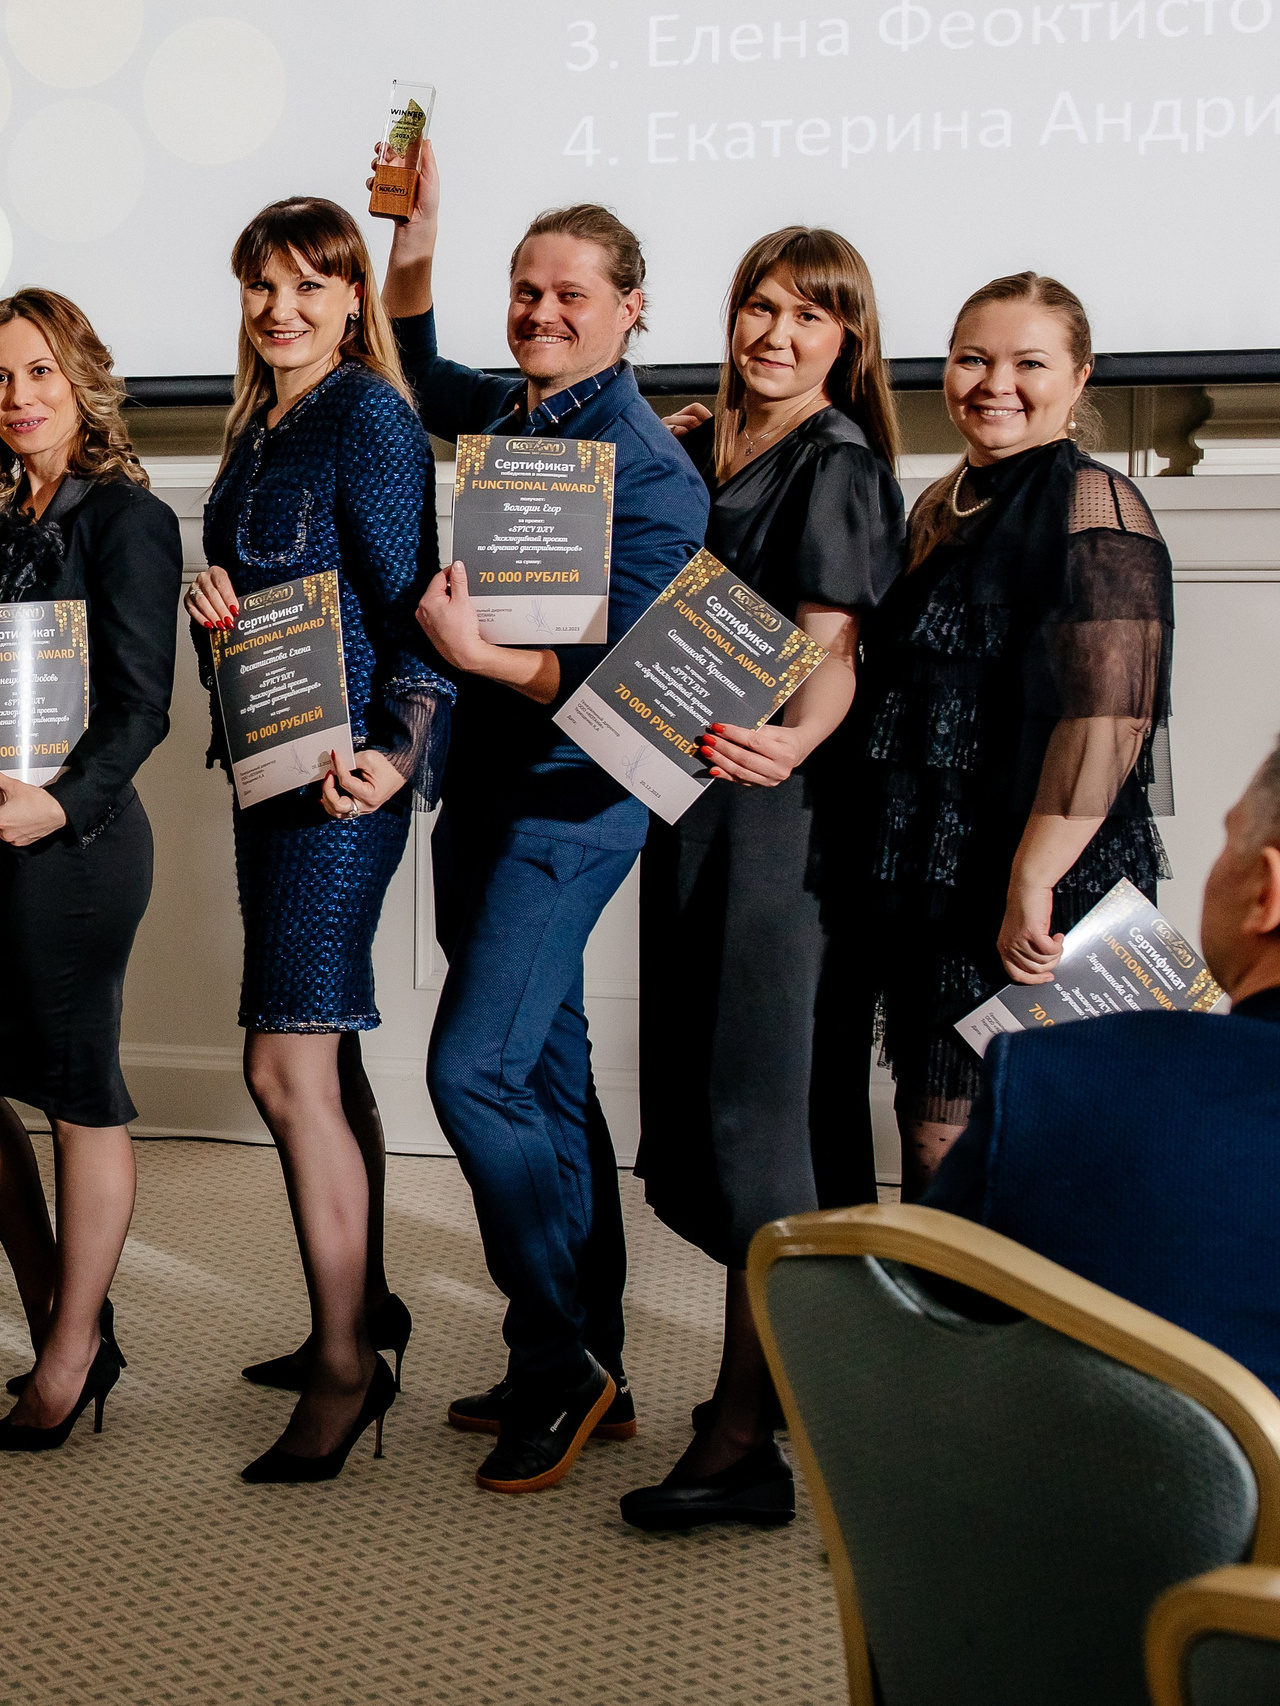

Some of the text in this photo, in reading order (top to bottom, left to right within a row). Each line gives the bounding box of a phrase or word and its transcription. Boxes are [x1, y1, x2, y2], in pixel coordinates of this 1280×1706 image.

[563, 19, 620, 72] 3.
[648, 15, 851, 67] Елена
[390, 108, 424, 120] WINNER
[562, 115, 620, 168] 4.
[647, 106, 1013, 169] Екатерина
[494, 458, 576, 472] Сертификат
[472, 480, 597, 493] FUNCTIONAL AWARD
[503, 502, 561, 515] Володин Егор
[479, 569, 579, 583] 70 000 РУБЛЕЙ
[237, 603, 304, 630] Сертификат
[706, 595, 775, 655] Сертификат
[224, 629, 284, 657] FUNCTIONAL
[285, 617, 325, 636] AWARD
[673, 599, 776, 687] FUNCTIONAL AWARD
[35, 648, 74, 660] AWARD
[634, 660, 643, 668] по
[667, 629, 746, 697] Ситникова Кристина
[245, 705, 323, 743] 70 000 РУБЛЕЙ
[614, 683, 702, 758] 70 000 РУБЛЕЙ
[0, 744, 23, 758] 000
[1128, 926, 1186, 990] Сертификат
[1028, 1003, 1046, 1020] 70
